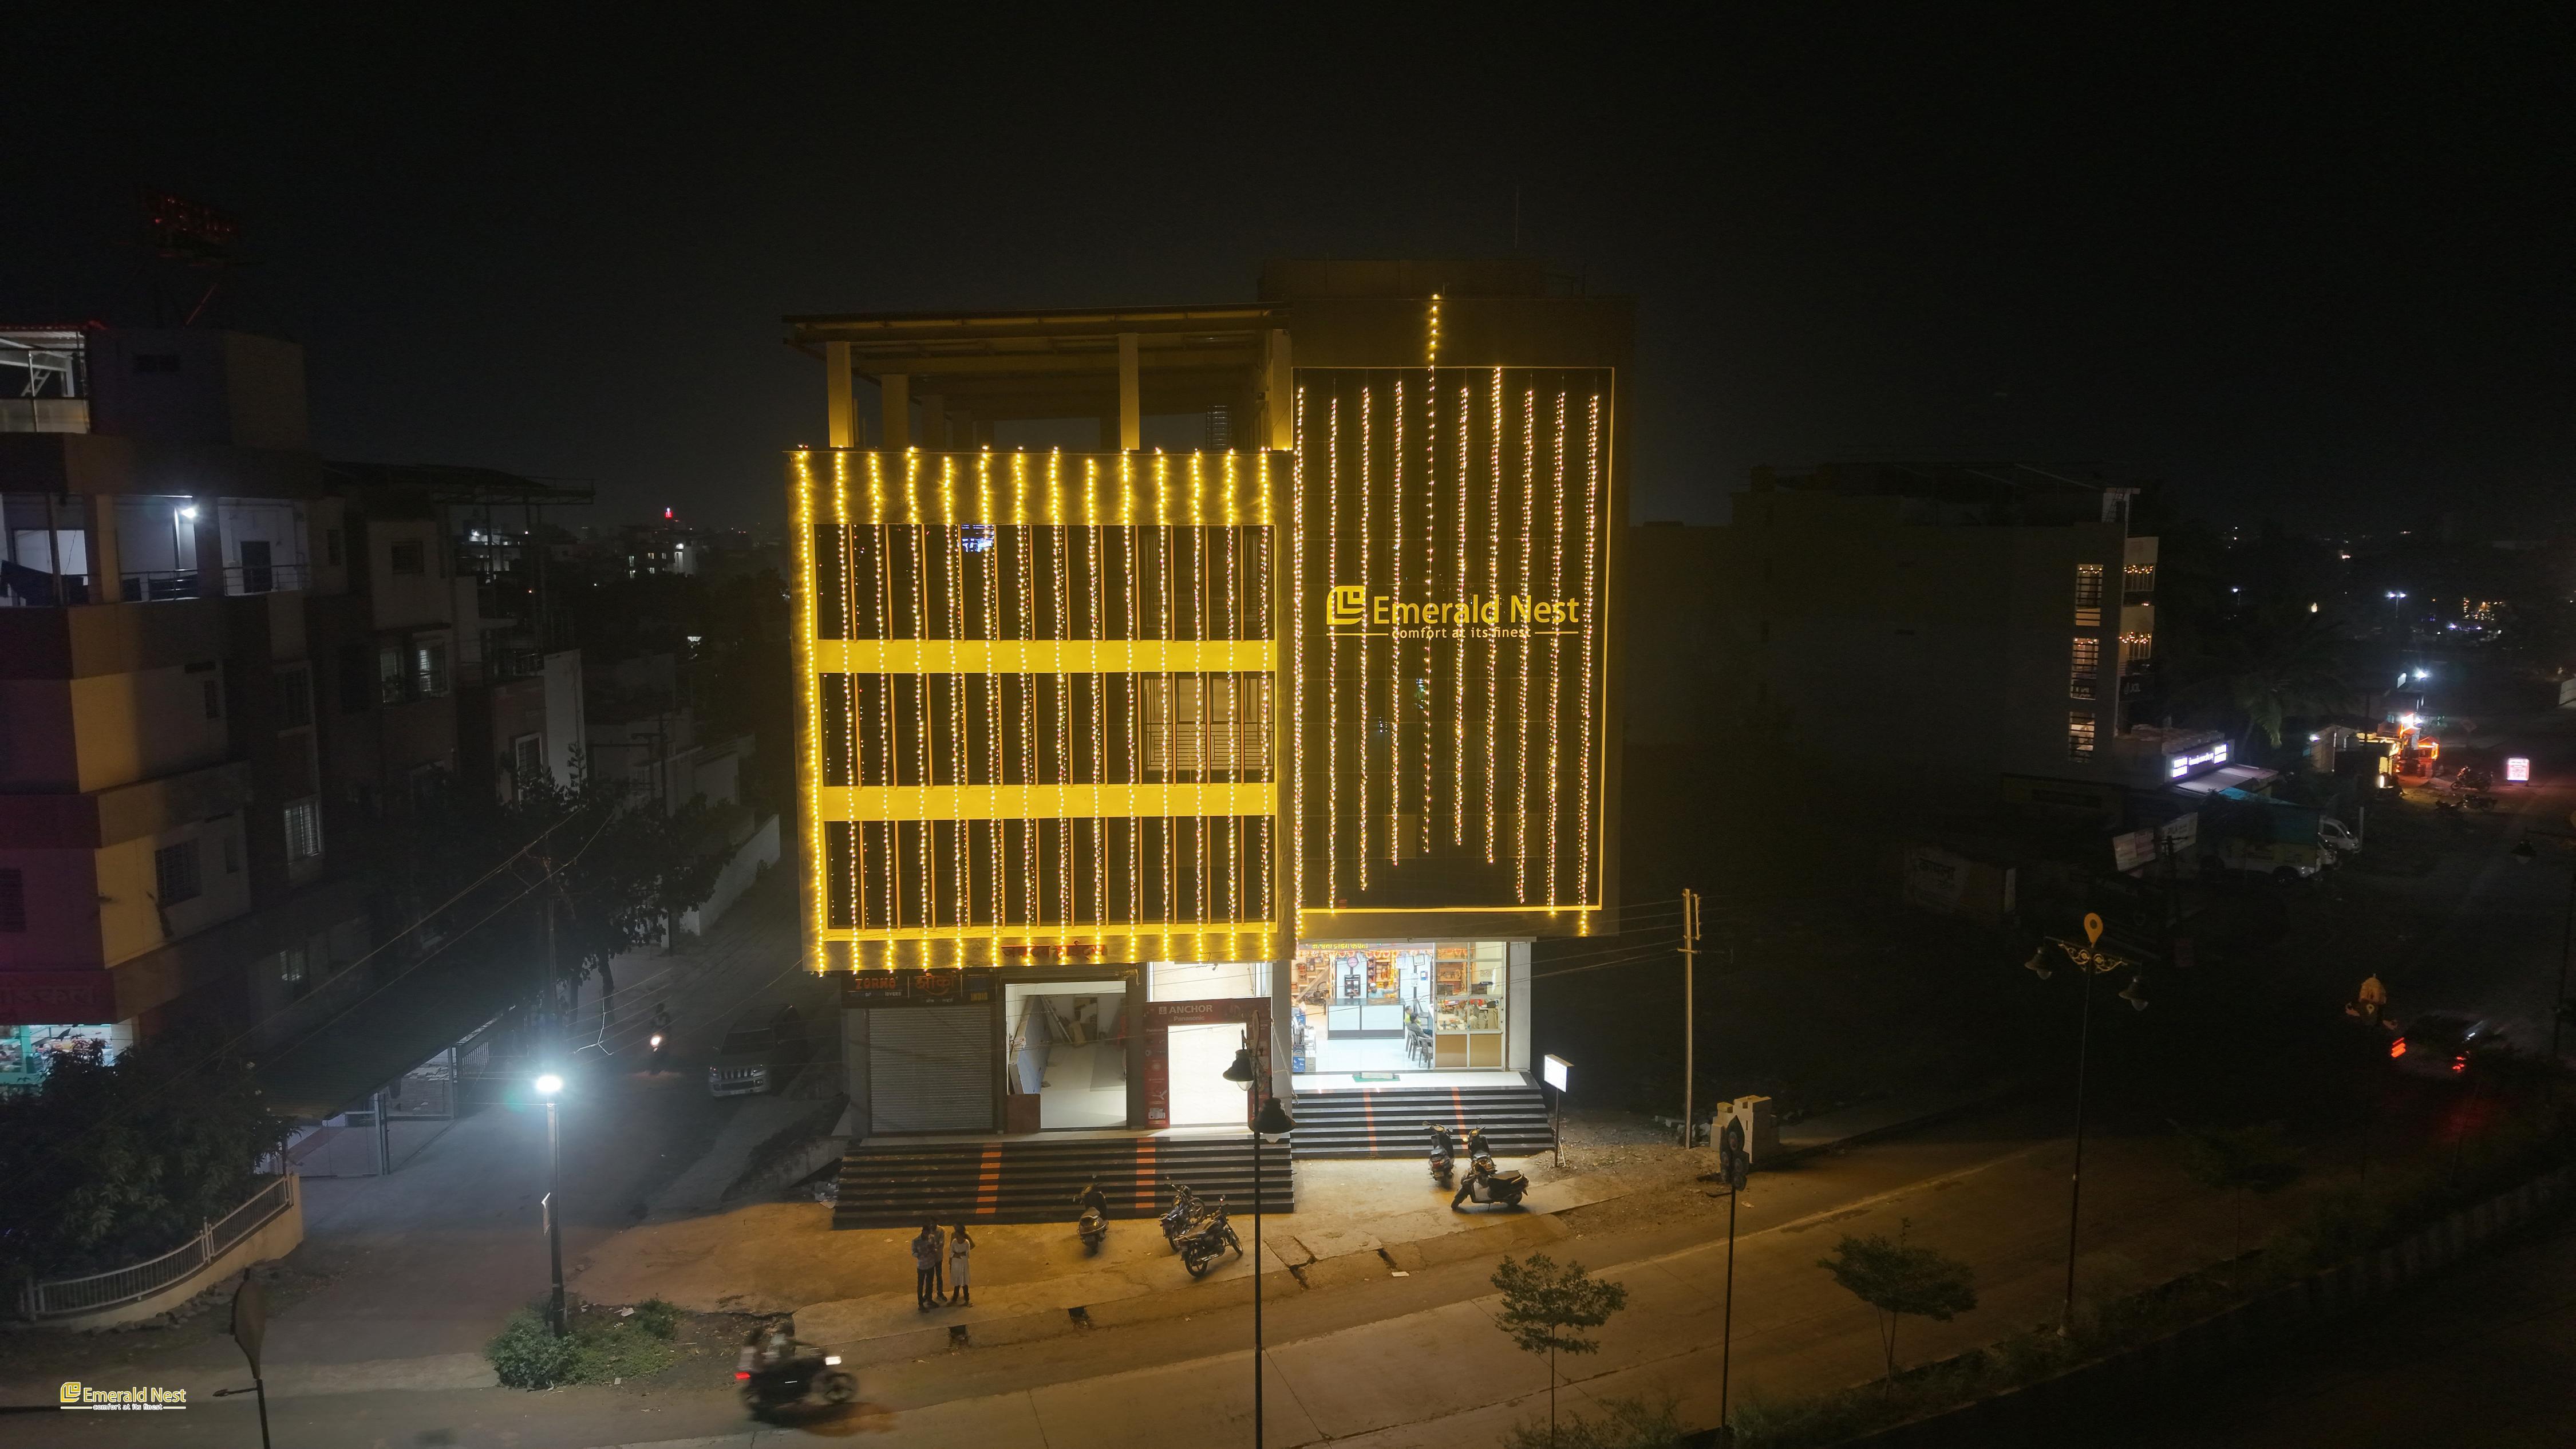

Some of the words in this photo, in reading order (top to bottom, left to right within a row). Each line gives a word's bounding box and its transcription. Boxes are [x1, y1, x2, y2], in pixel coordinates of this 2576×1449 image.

[1374, 594, 1499, 625] Emerald
[1511, 594, 1579, 624] Nest
[1392, 627, 1447, 639] comfort
[1452, 628, 1465, 638] at
[1471, 627, 1488, 638] its
[1492, 627, 1531, 638] finest
[1169, 1005, 1213, 1014] ANCHOR
